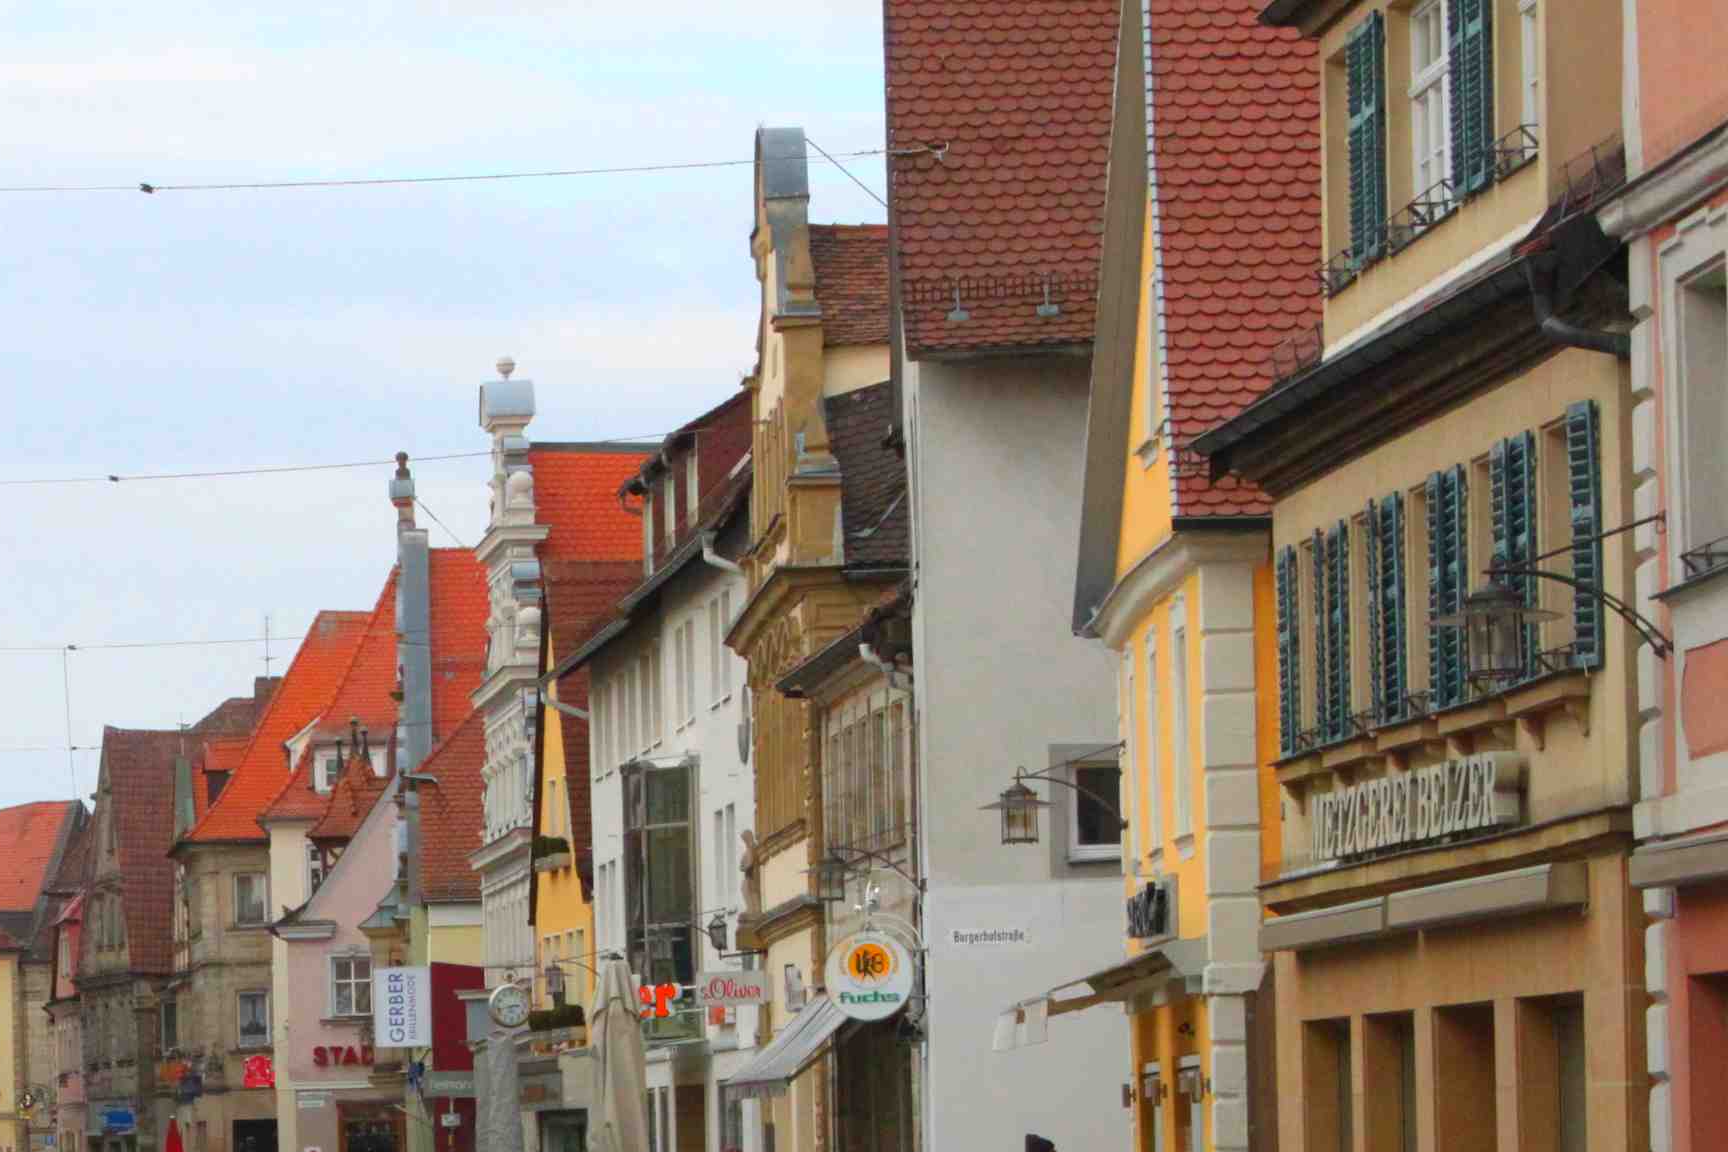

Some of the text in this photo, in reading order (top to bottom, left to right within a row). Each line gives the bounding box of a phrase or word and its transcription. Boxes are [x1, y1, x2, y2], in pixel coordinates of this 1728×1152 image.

[1312, 752, 1497, 862] METZGEREI BELZER
[389, 973, 405, 1042] GERBER
